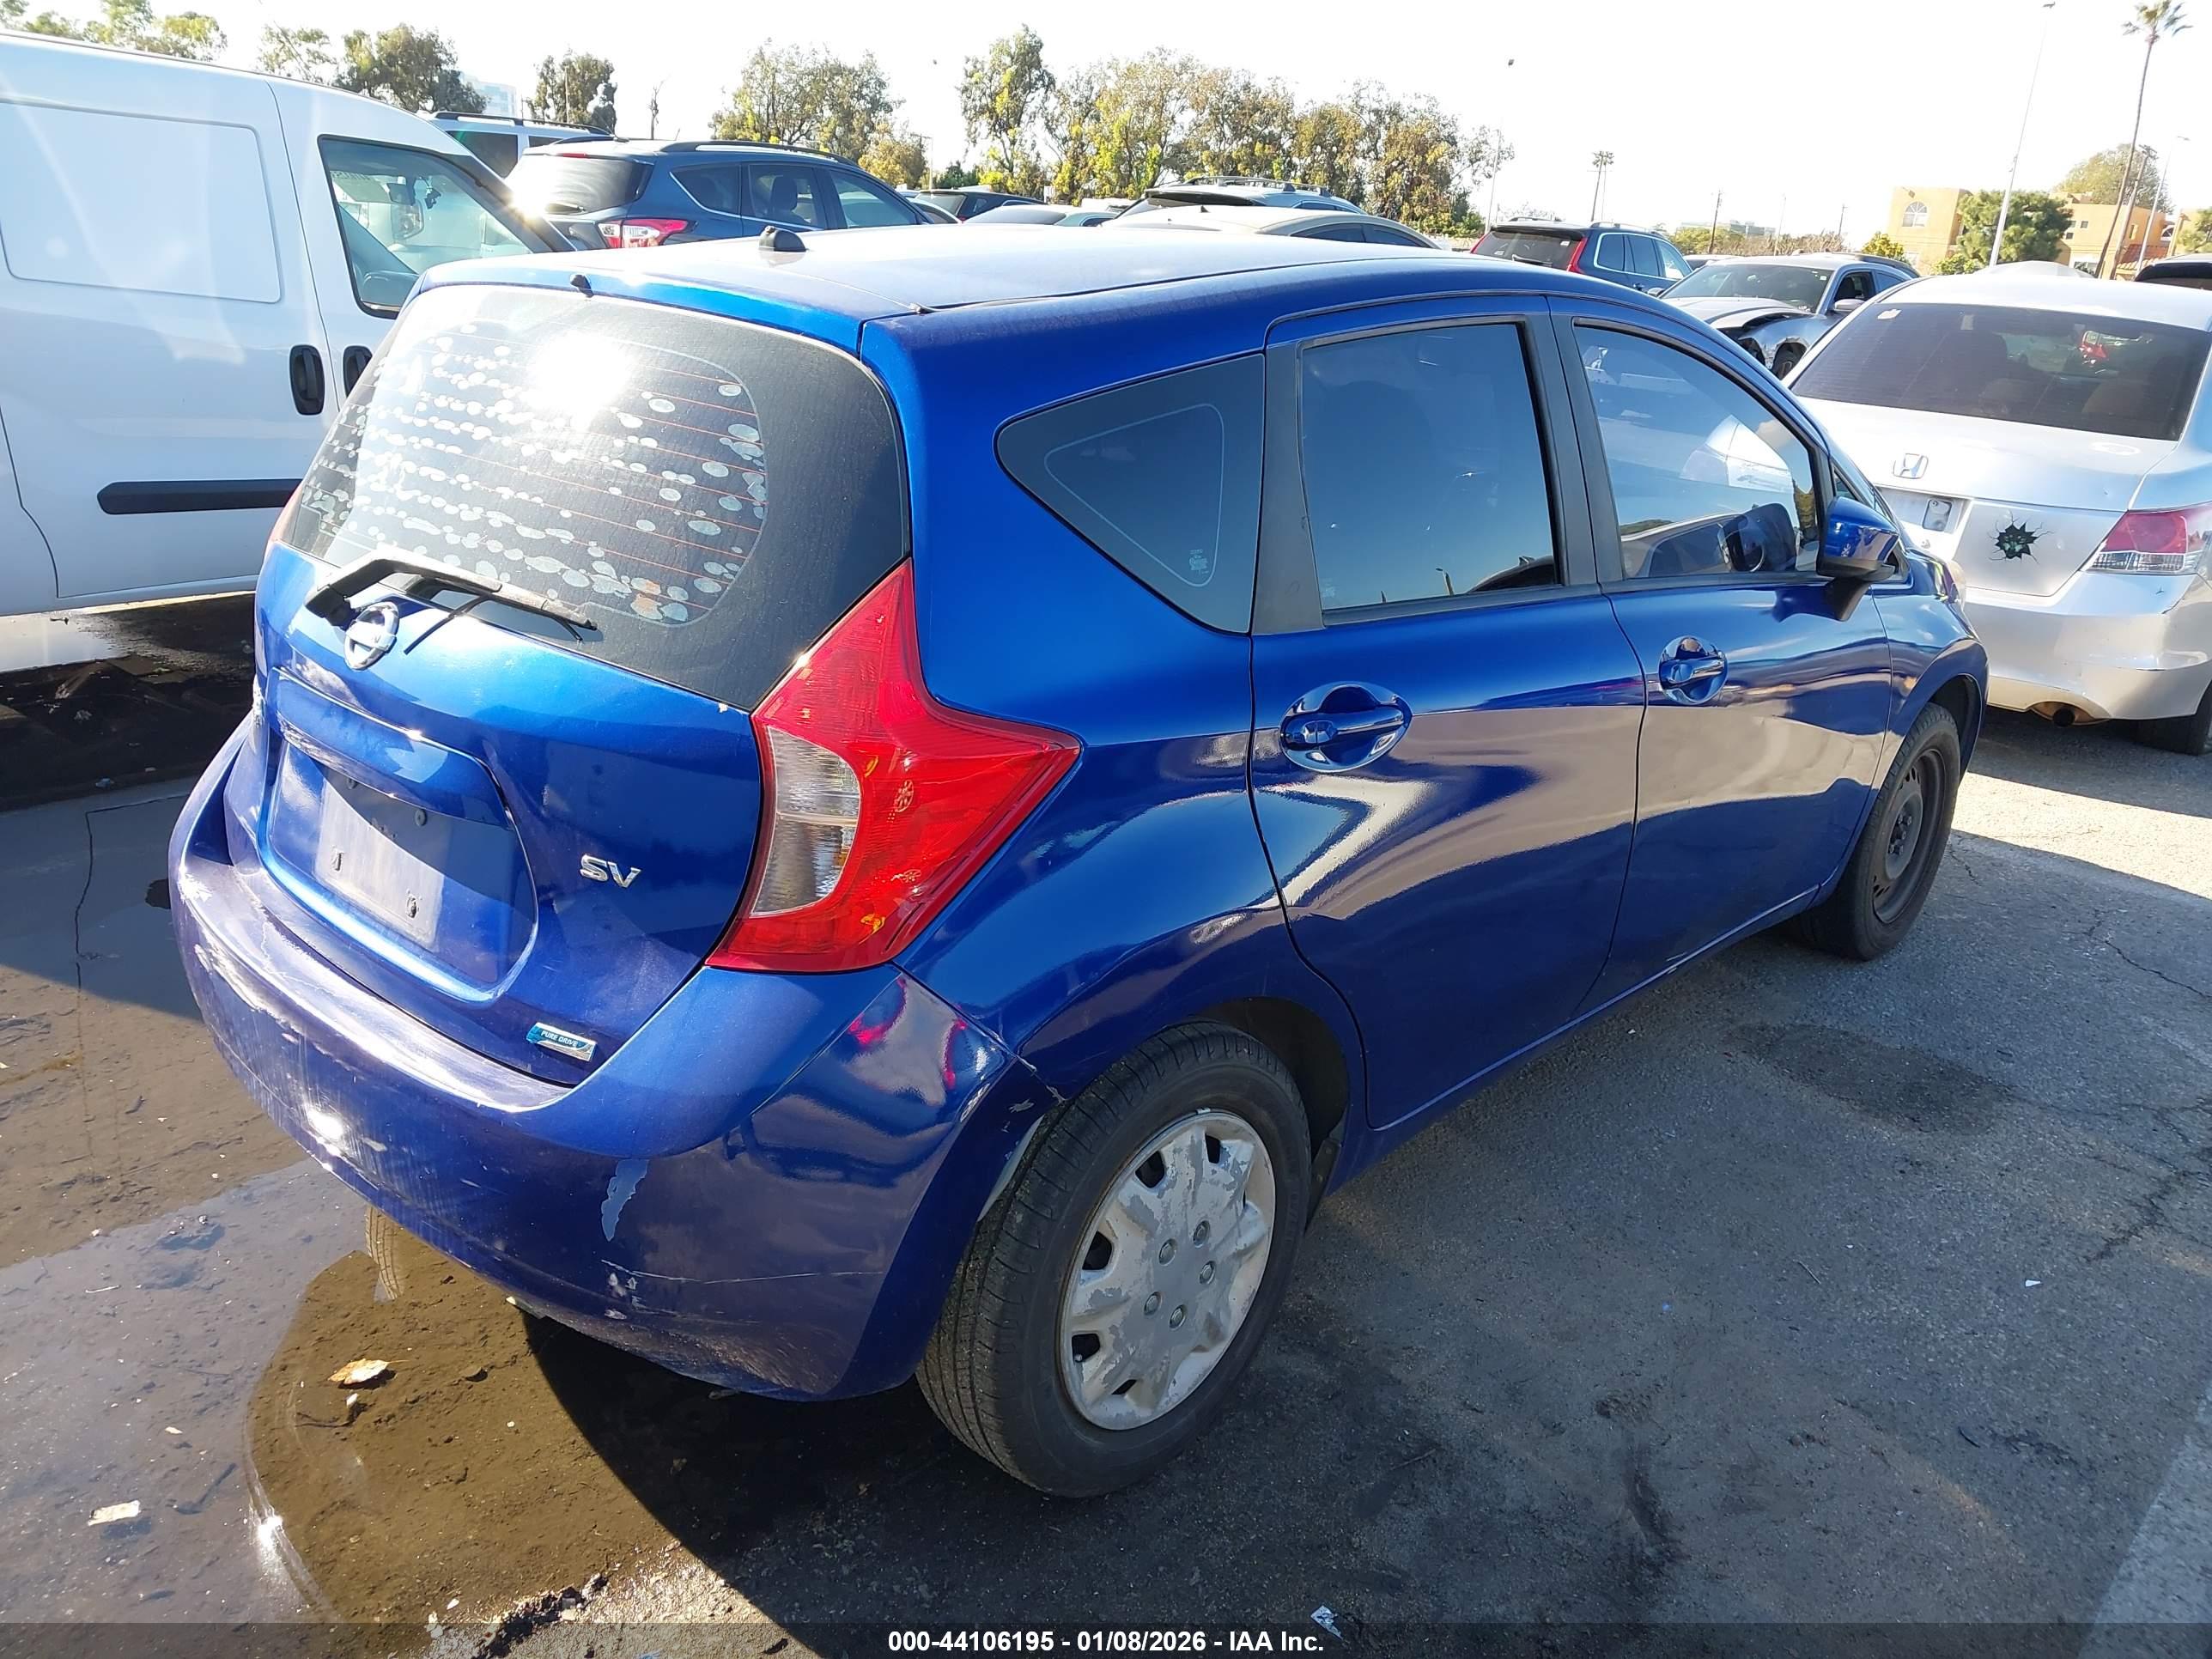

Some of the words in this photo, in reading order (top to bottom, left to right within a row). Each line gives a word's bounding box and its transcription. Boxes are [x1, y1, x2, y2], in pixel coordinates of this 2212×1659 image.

[580, 854, 641, 888] SV
[541, 1030, 558, 1041] PURE
[558, 1036, 579, 1047] DRIVE
